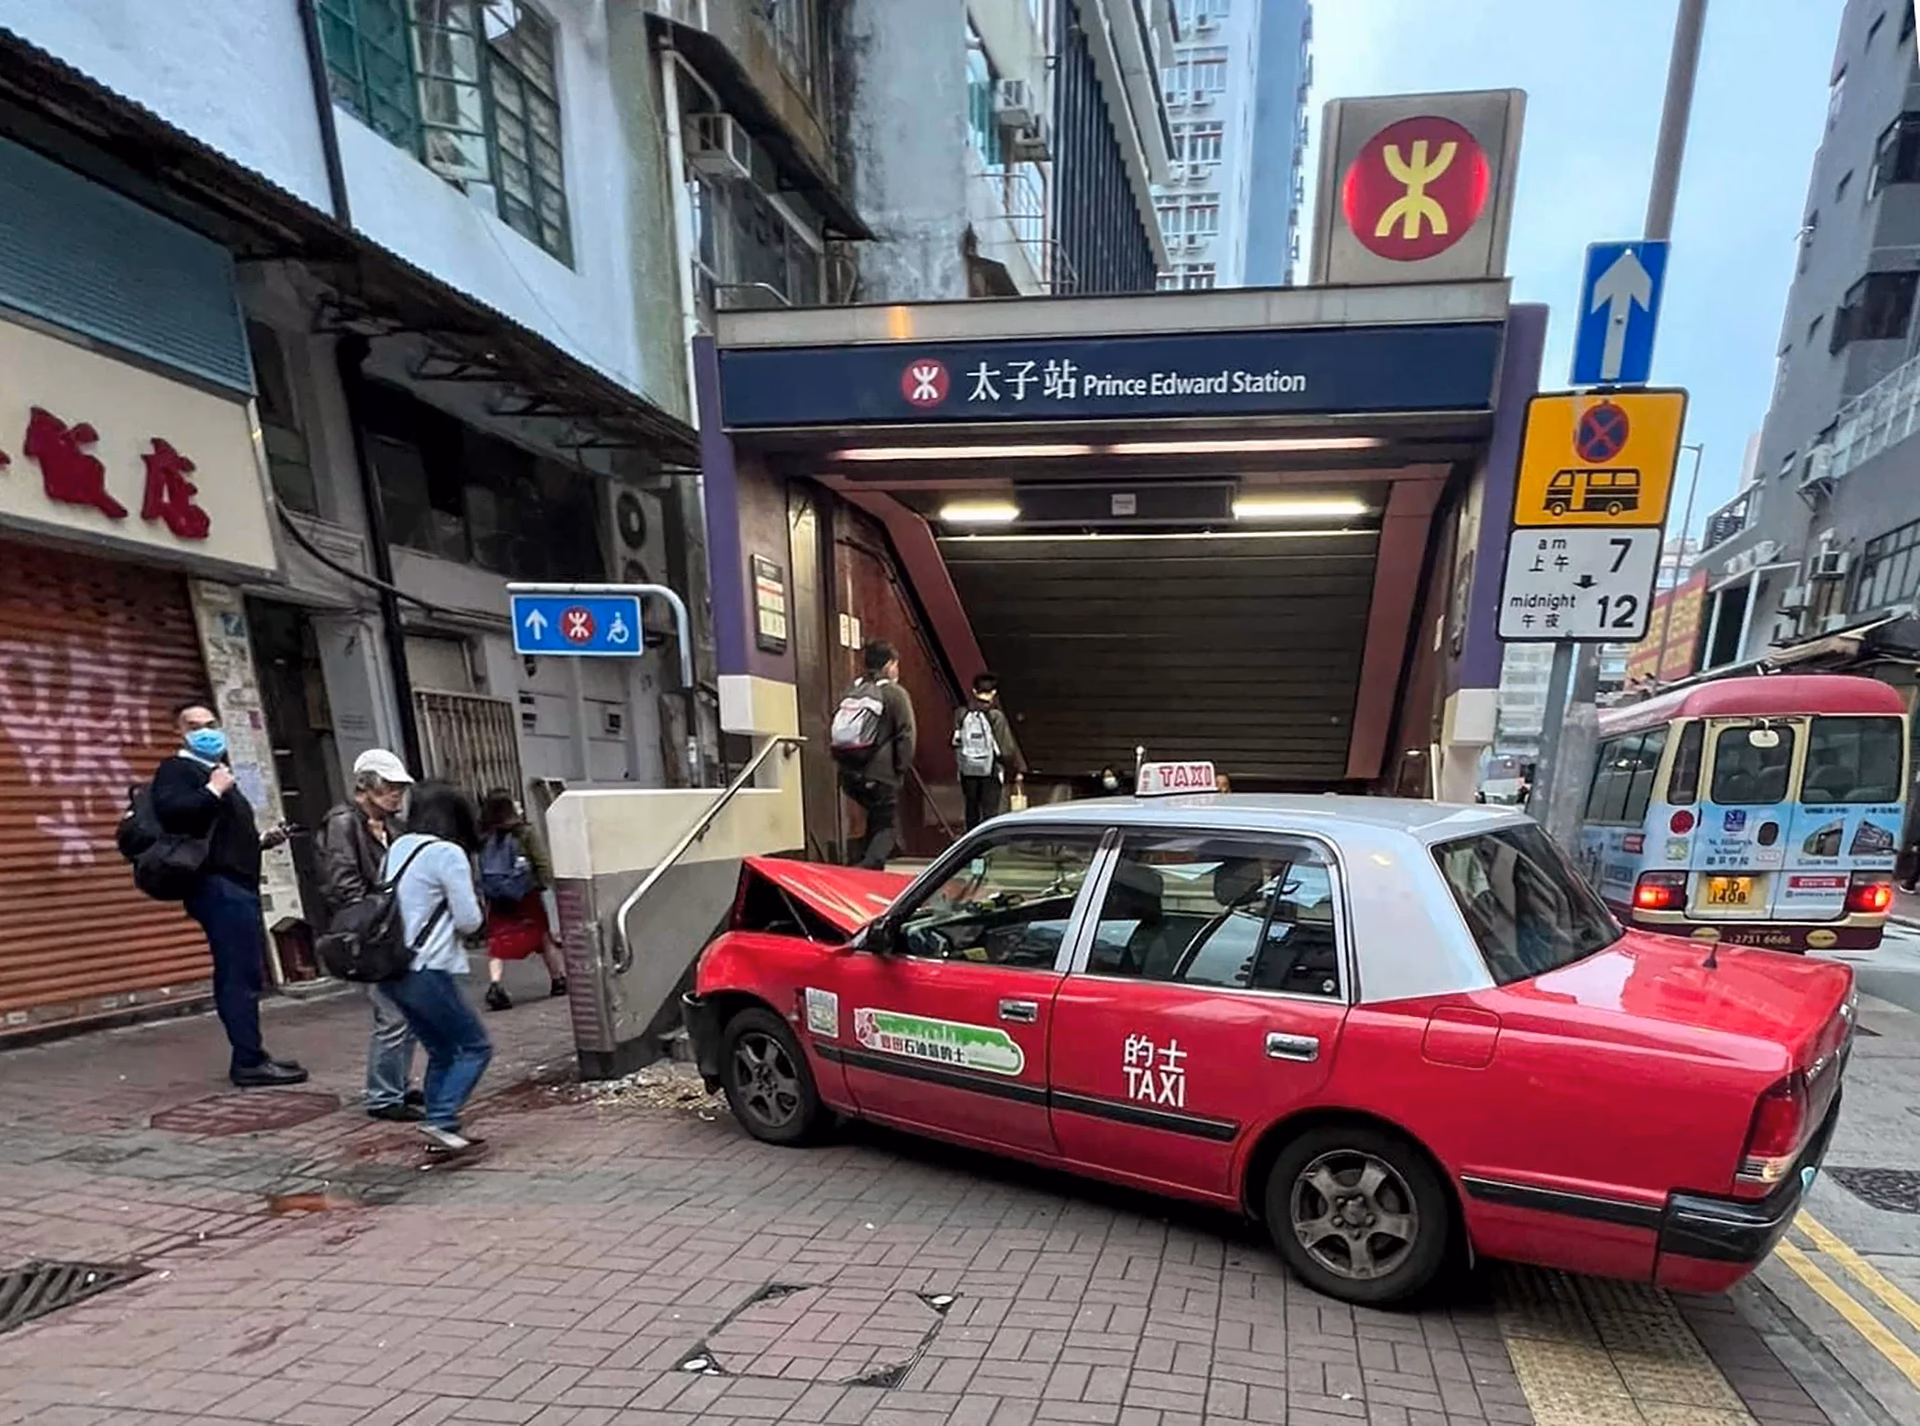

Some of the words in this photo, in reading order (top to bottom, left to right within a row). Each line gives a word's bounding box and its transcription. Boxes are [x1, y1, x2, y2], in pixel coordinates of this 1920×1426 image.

[966, 359, 1079, 402] 太子站
[1084, 374, 1147, 397] Prince
[1150, 371, 1228, 396] Edward
[1231, 370, 1306, 394] Station
[0, 406, 211, 539] 飯店
[1528, 554, 1569, 572] 上午
[1609, 538, 1633, 573] 7
[1510, 594, 1576, 610] midnight
[1597, 594, 1638, 628] 12
[1522, 613, 1560, 629] 午夜
[1159, 765, 1212, 787] TAXI
[1124, 1033, 1188, 1073] 的士
[1123, 1066, 1185, 1107] TAXI
